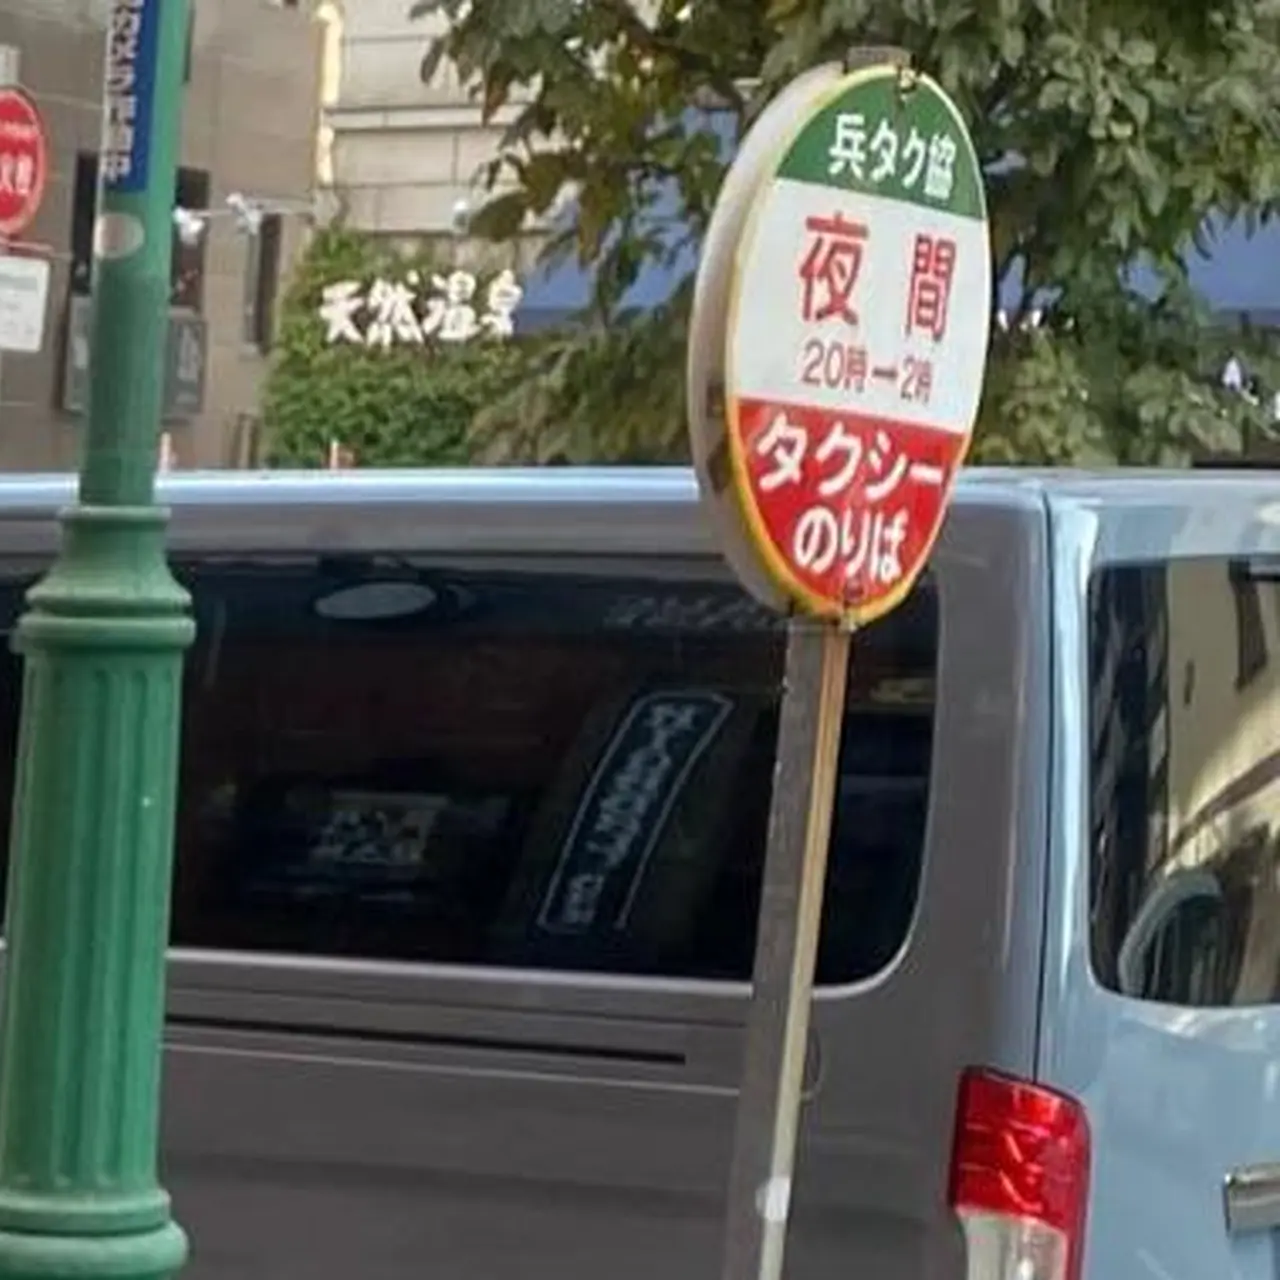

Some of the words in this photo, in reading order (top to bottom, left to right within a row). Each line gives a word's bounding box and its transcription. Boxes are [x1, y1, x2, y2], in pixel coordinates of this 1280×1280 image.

[829, 113, 957, 199] 兵タク協
[319, 269, 523, 347] 天然温泉
[799, 211, 957, 343] 夜間
[756, 412, 944, 501] タクシー
[794, 505, 909, 583] のりば
